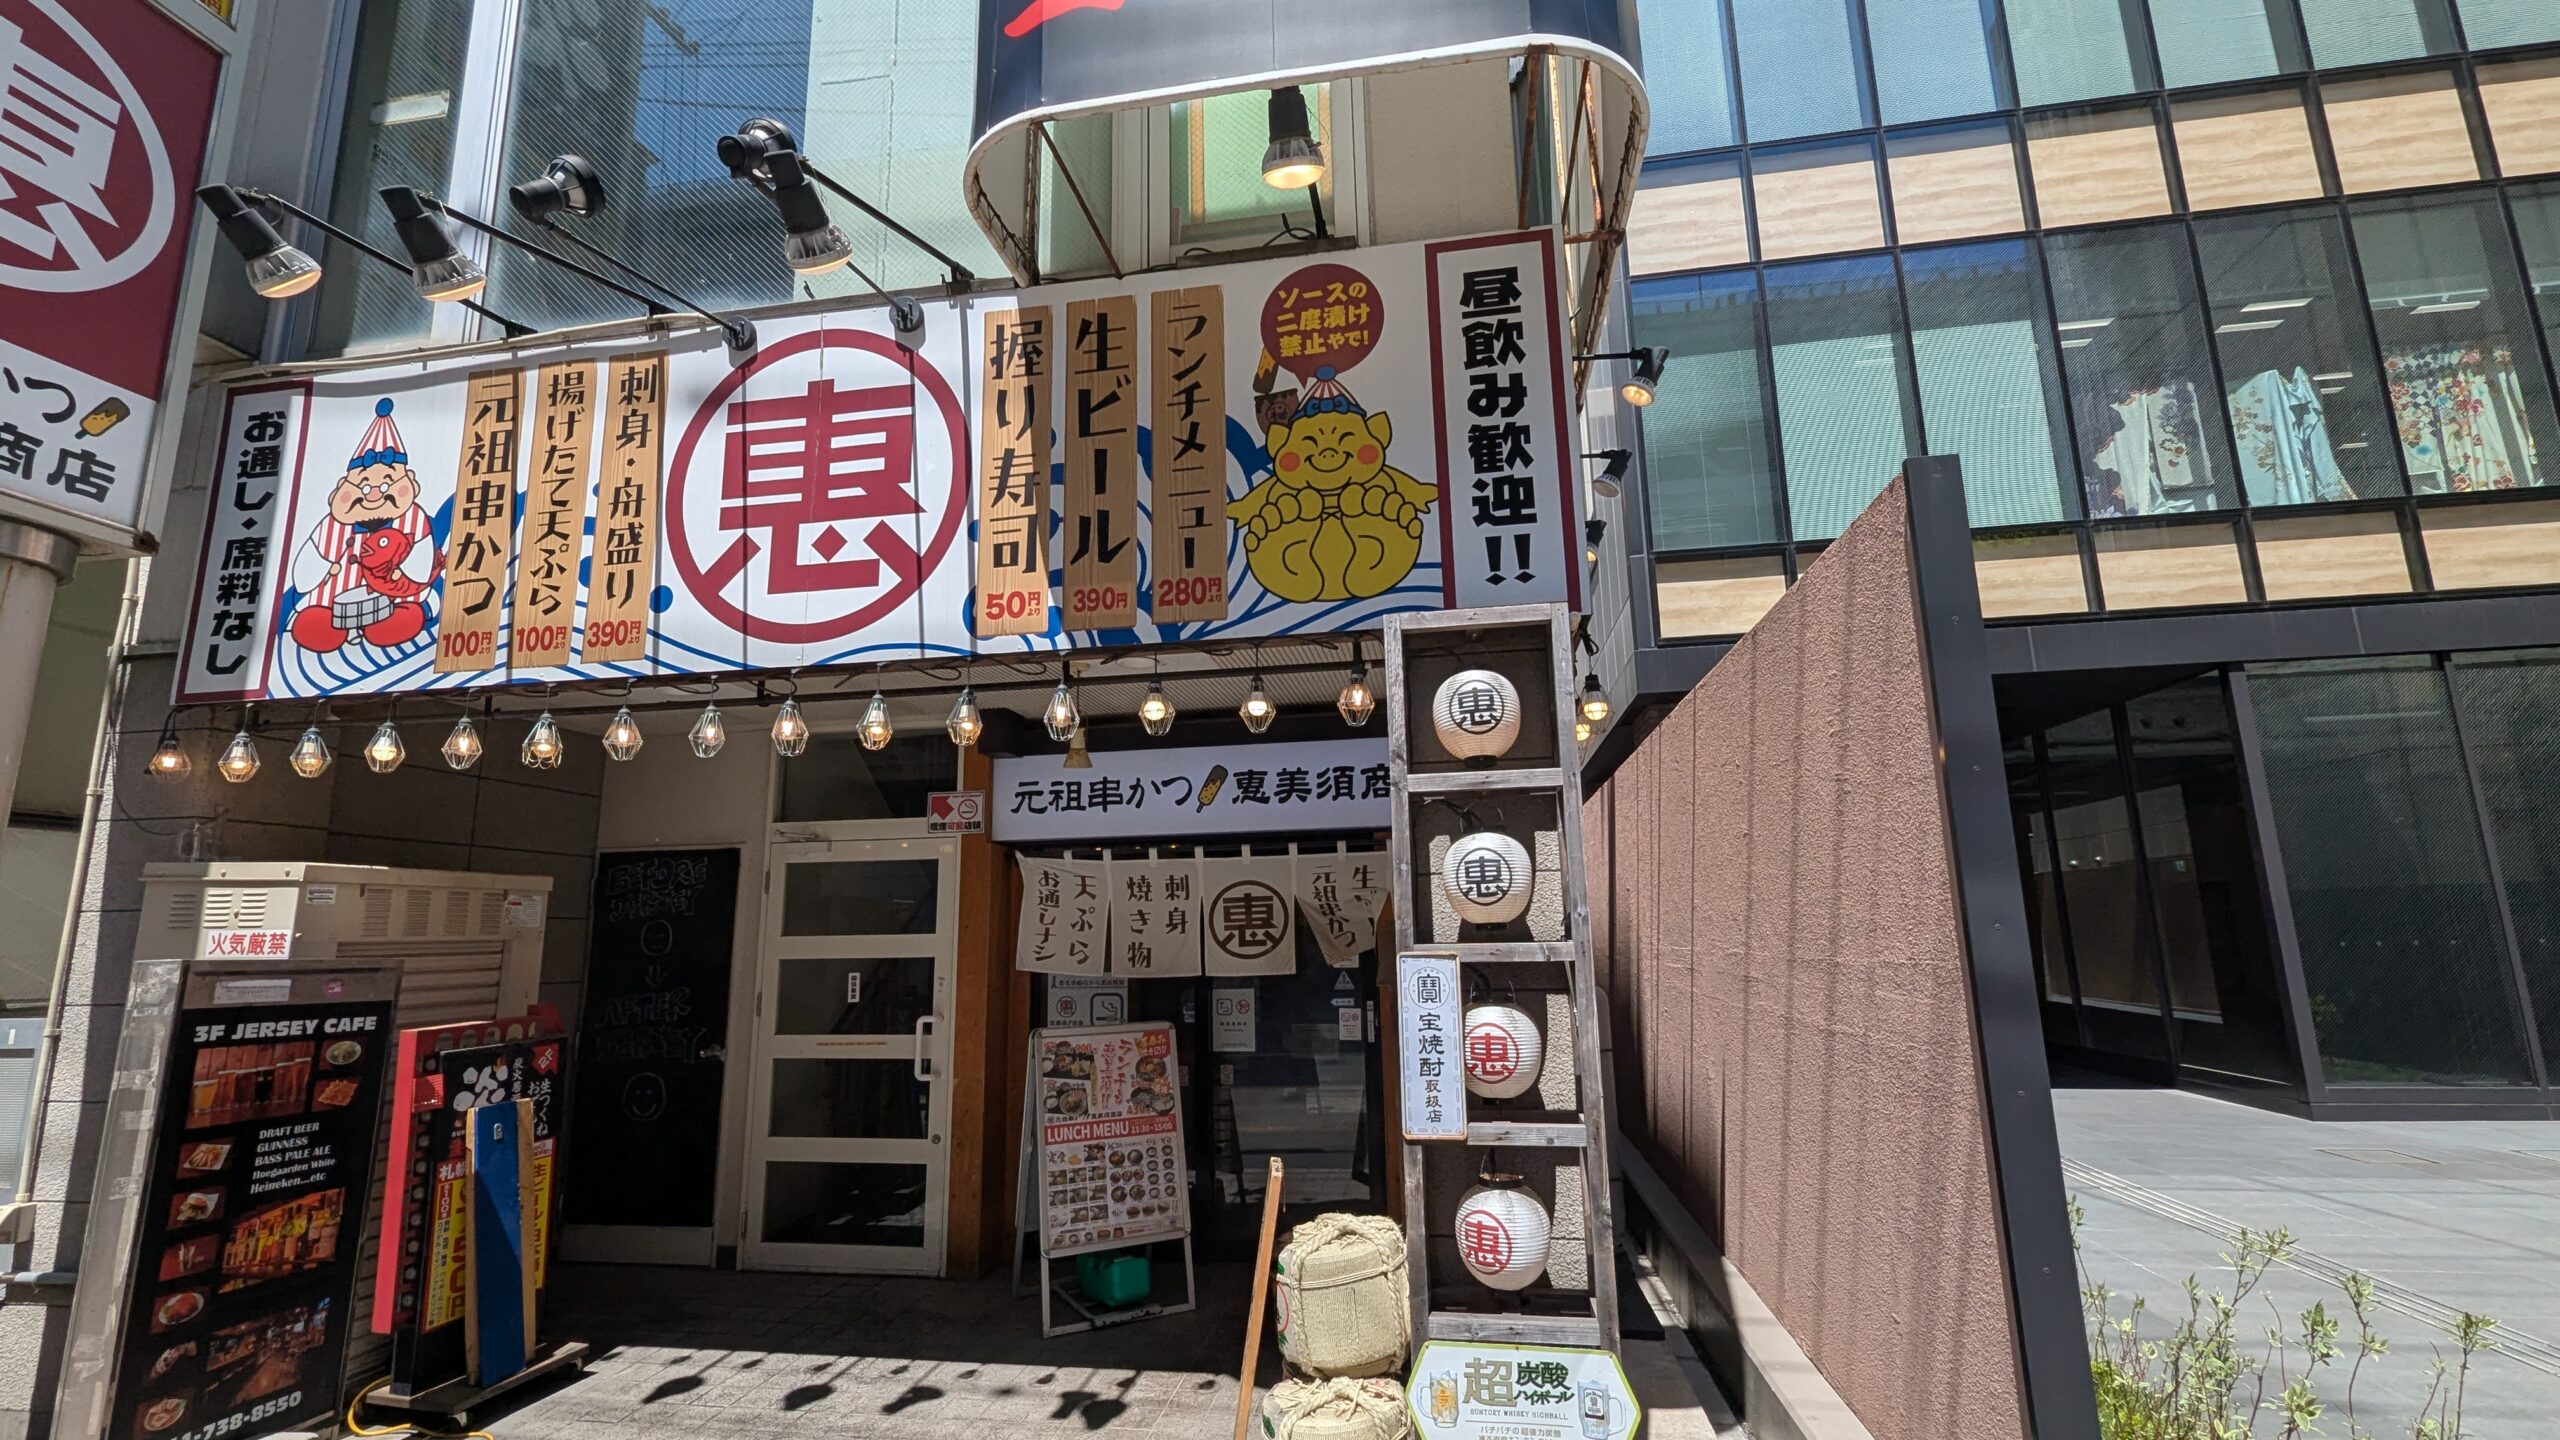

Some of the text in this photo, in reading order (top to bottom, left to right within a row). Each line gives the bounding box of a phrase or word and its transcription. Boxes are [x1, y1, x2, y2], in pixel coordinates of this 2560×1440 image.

[1276, 303, 1370, 333] 二度漬け
[1278, 282, 1368, 309] ソースの
[1279, 330, 1369, 357] 禁止やで!
[3, 366, 77, 424] つ
[989, 319, 1044, 574] 握り寿司
[1070, 312, 1132, 566] 生ビール
[1166, 304, 1213, 569] ランチメニュー
[1460, 266, 1537, 586] 昼飲み歓迎!!
[452, 381, 518, 617] 元祖串かつ
[529, 371, 586, 617] 揚げたて天ぷら
[604, 363, 658, 610] 刺身・舟盛り
[696, 374, 936, 605] 恵
[206, 410, 287, 676] お通し・席料なし
[1073, 587, 1127, 613] 390円
[1455, 685, 1501, 728] 恵
[1010, 776, 1193, 815] 元祖串かつ
[1463, 855, 1505, 899] 恵
[1032, 870, 1060, 962] お通しナシ
[1070, 874, 1097, 966] 天ぷら
[1126, 875, 1153, 969] 焼き物
[1165, 874, 1190, 935] 刺身
[1217, 891, 1283, 950] 恵
[1312, 865, 1357, 948] 元祖串かつ
[208, 932, 288, 957] 火気厳禁
[193, 1016, 378, 1043] 3F JERSEY CAFE
[538, 1046, 555, 1070] 2F
[1465, 1032, 1516, 1079] 恵
[258, 1122, 320, 1140] DRAFT BEER
[536, 1078, 552, 1137] 生つくね
[1047, 1124, 1091, 1143] LUNCH
[1093, 1120, 1129, 1139] MENU
[254, 1145, 333, 1167] BASS PALE ALE
[256, 1136, 309, 1153] GUINNESS
[1461, 1219, 1502, 1270] 恵
[1462, 1357, 1518, 1408] 超
[1515, 1360, 1572, 1391] 炭酸
[1513, 1389, 1575, 1406] ハイボール
[1470, 1408, 1501, 1417] SUNTORY
[1503, 1410, 1530, 1419] WHISKY
